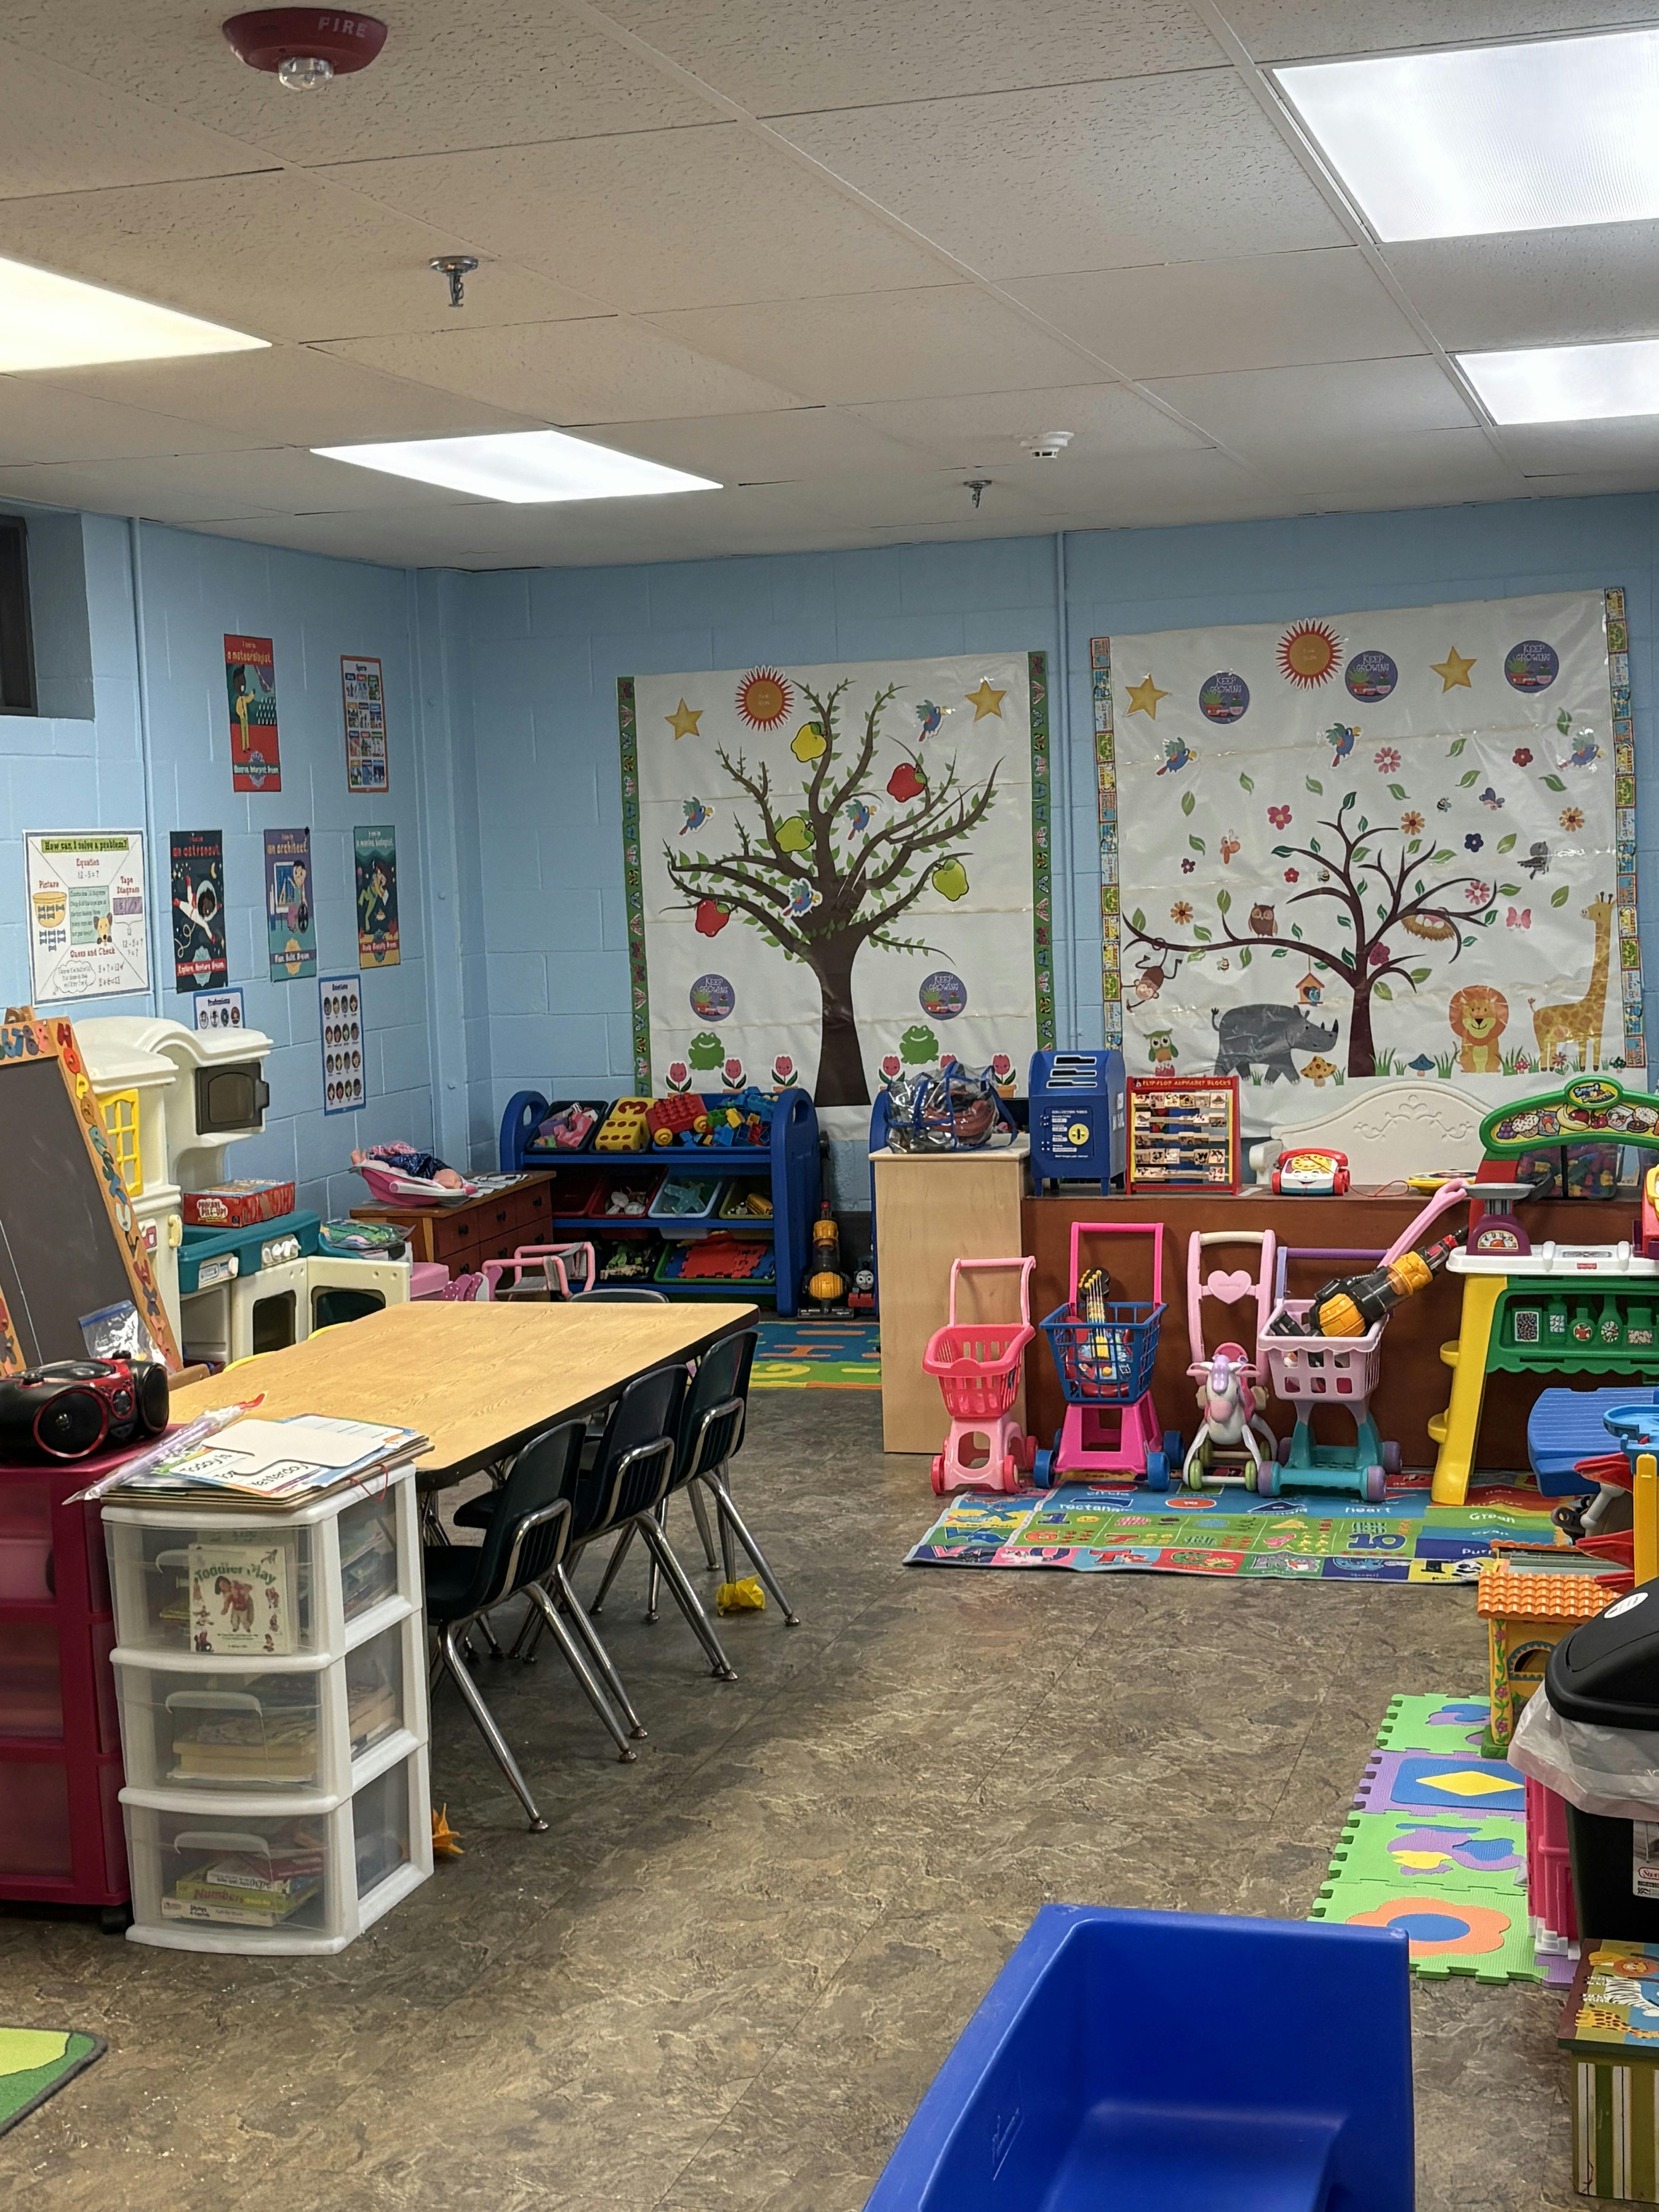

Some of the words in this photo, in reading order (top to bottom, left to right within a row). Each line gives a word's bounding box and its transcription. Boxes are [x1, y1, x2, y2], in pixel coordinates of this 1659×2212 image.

[318, 17, 368, 38] FIRE
[1523, 644, 1546, 654] KEEP
[1362, 654, 1384, 665] KEEP
[1516, 653, 1551, 662] GROWING
[1356, 663, 1390, 672] GROWING
[1216, 675, 1237, 685] KEEP
[1210, 685, 1242, 693] GROWING
[45, 840, 58, 850] How
[60, 840, 72, 850] can
[78, 840, 94, 849] solve
[76, 858, 100, 868] Equation
[39, 880, 59, 889] Picture
[120, 876, 133, 885] Tape
[117, 886, 140, 895] Diagram
[70, 950, 86, 958] Guess
[87, 948, 97, 957] and
[98, 946, 115, 955] Check
[705, 976, 723, 986] KEEP
[934, 975, 954, 985] KEEP
[929, 983, 959, 991] GROWING
[179, 1458, 223, 1473] Today
[247, 1463, 309, 1487] Yesterday
[1469, 1512, 1515, 1523] Green
[1348, 1533, 1406, 1549] 10
[194, 1561, 242, 1583] Toddler
[194, 1888, 244, 1904] Numbers
